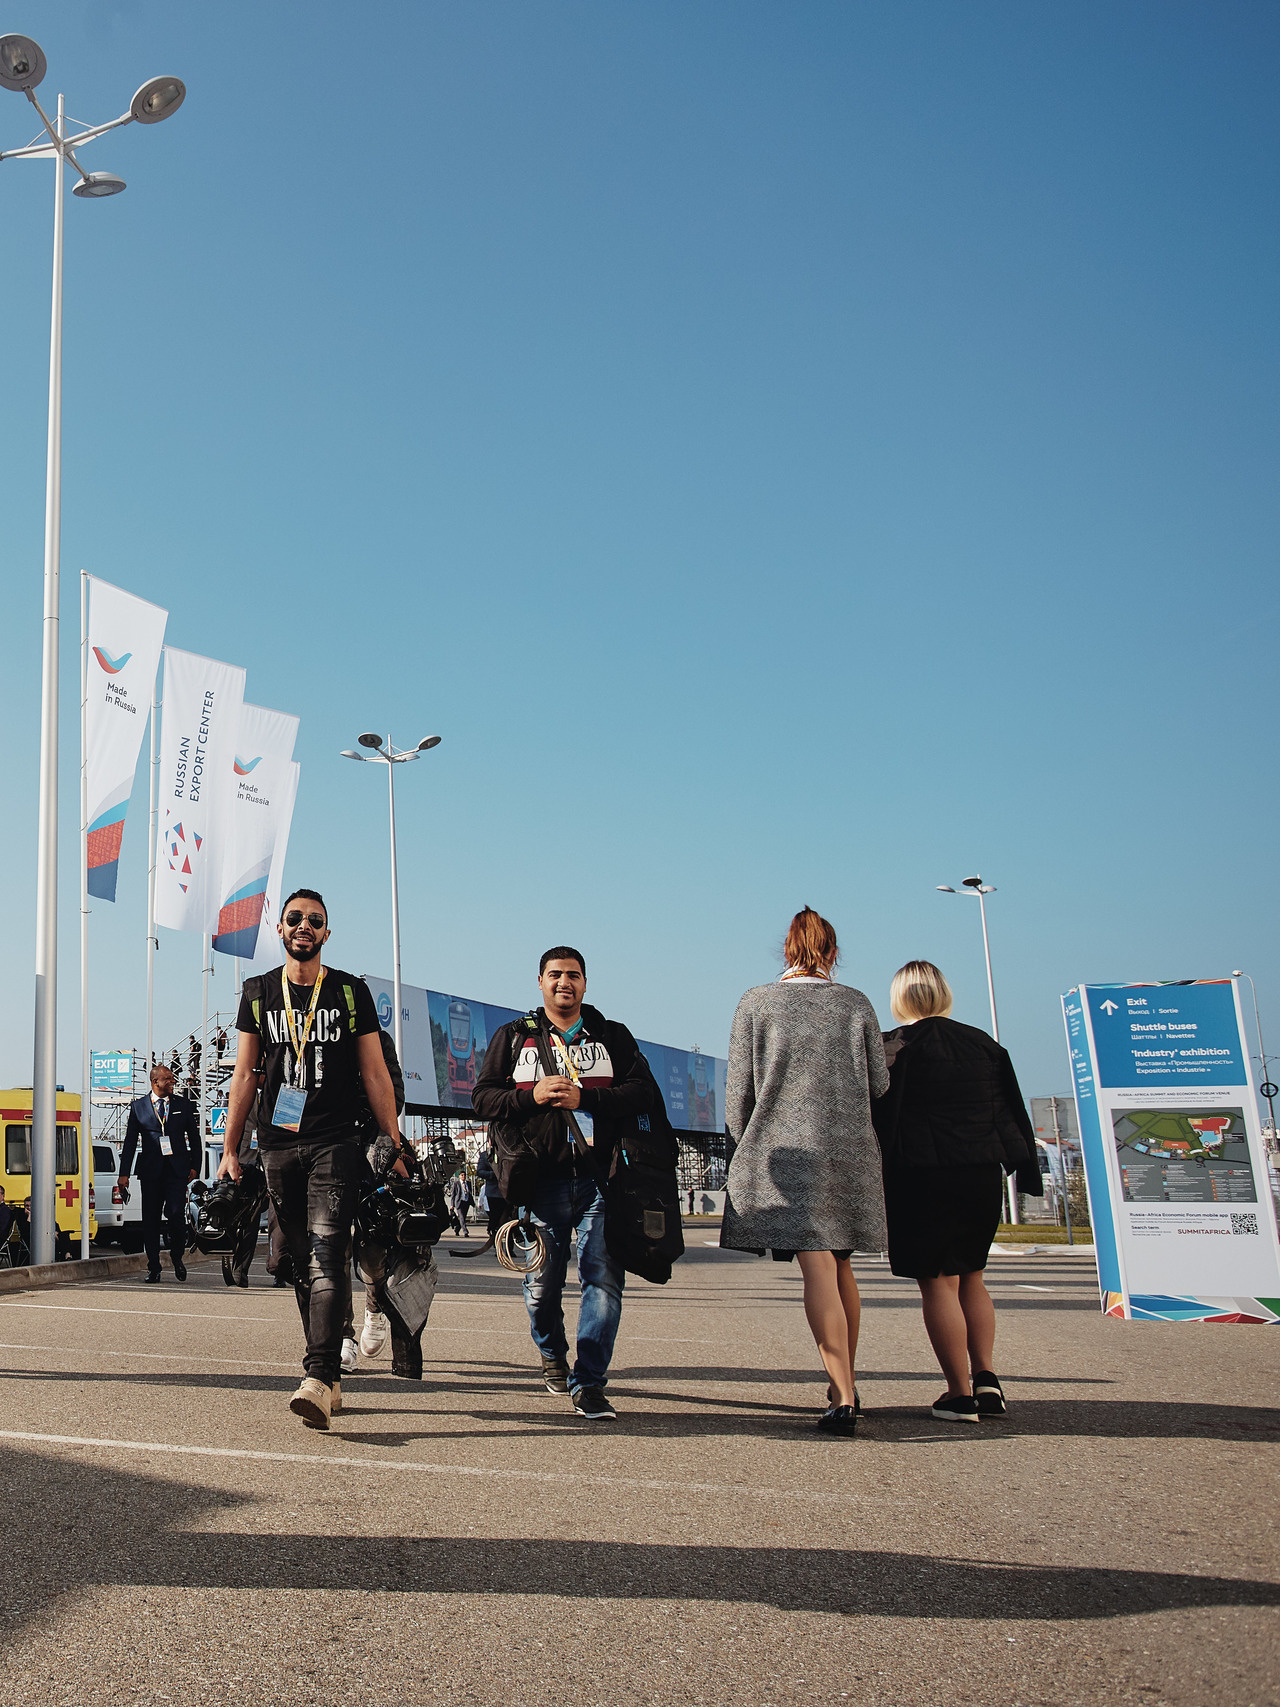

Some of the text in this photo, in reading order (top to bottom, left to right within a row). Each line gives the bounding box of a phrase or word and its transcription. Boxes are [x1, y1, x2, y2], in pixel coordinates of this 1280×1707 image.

[107, 682, 127, 697] Made
[105, 693, 137, 714] in Russia
[189, 690, 215, 802] EXPORT CENTER
[174, 736, 191, 798] RUSSIAN
[238, 782, 259, 793] Made
[237, 791, 270, 806] in Russia
[1126, 998, 1148, 1006] Exit
[1130, 1023, 1167, 1032] Shuttle
[1179, 1047, 1230, 1056] exhibition
[94, 1059, 116, 1069] EXIT
[1136, 1067, 1171, 1075] Exposition
